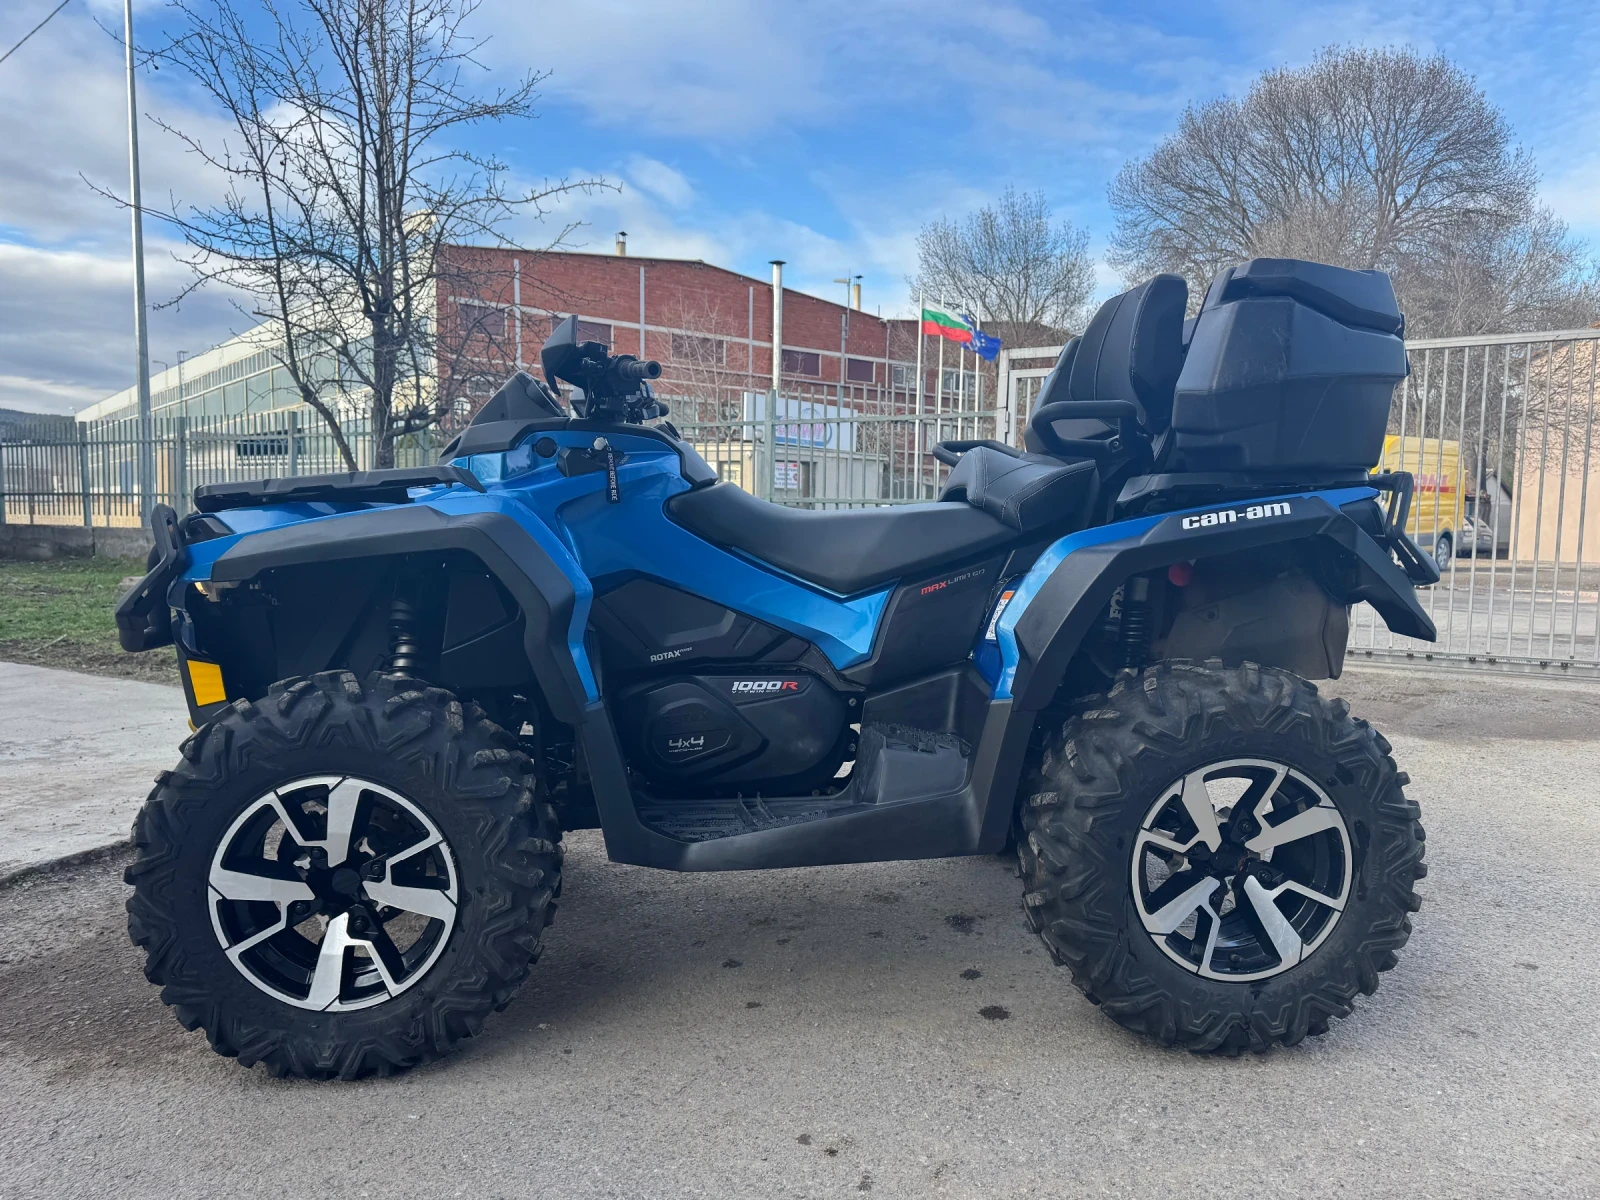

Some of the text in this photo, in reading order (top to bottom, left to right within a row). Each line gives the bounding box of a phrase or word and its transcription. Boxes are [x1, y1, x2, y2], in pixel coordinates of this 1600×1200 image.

[1182, 502, 1291, 530] can-am
[921, 581, 947, 595] MAX
[650, 650, 681, 662] ROTAX
[732, 681, 798, 690] 1000R
[668, 735, 705, 748] 4x4
